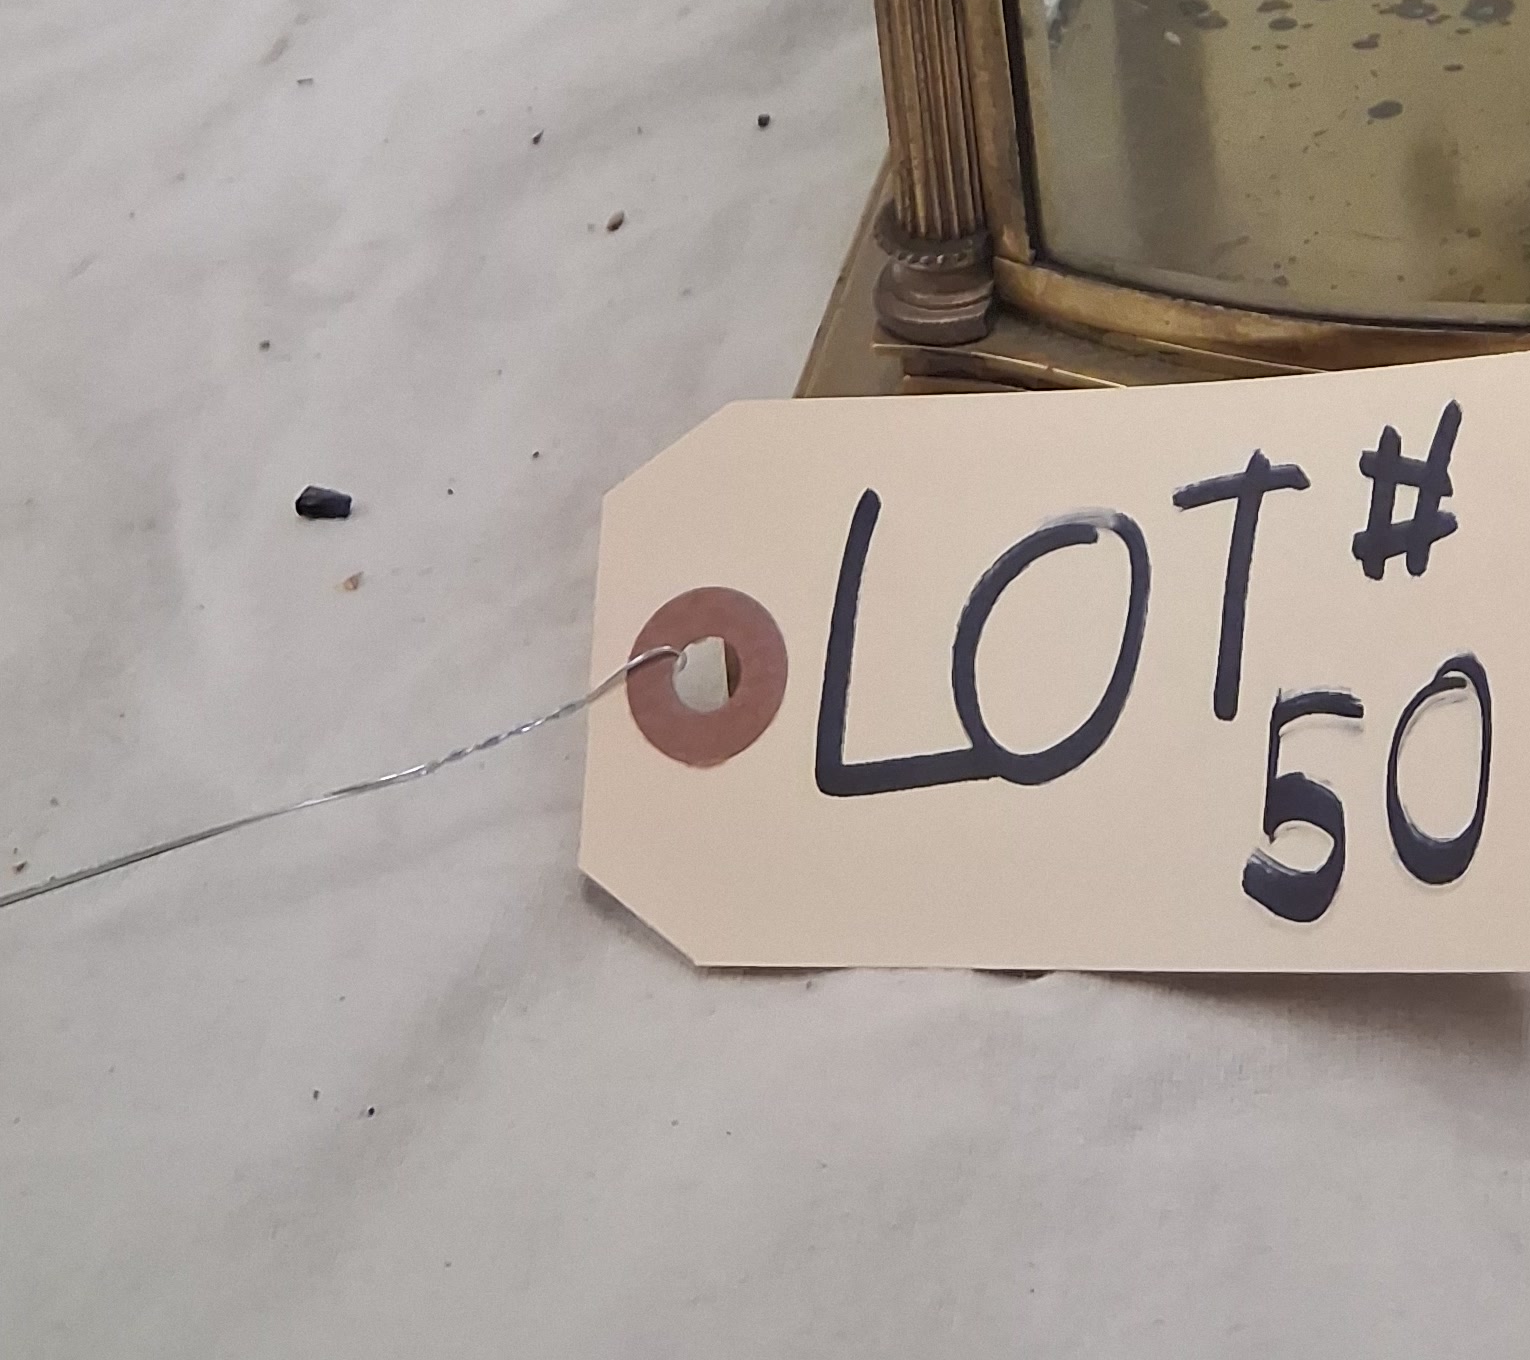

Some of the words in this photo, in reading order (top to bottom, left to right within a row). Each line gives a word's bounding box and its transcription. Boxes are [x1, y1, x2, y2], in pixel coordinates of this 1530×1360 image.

[815, 449, 1311, 798] LOT
[1351, 400, 1462, 580] #
[1242, 652, 1492, 923] 50
